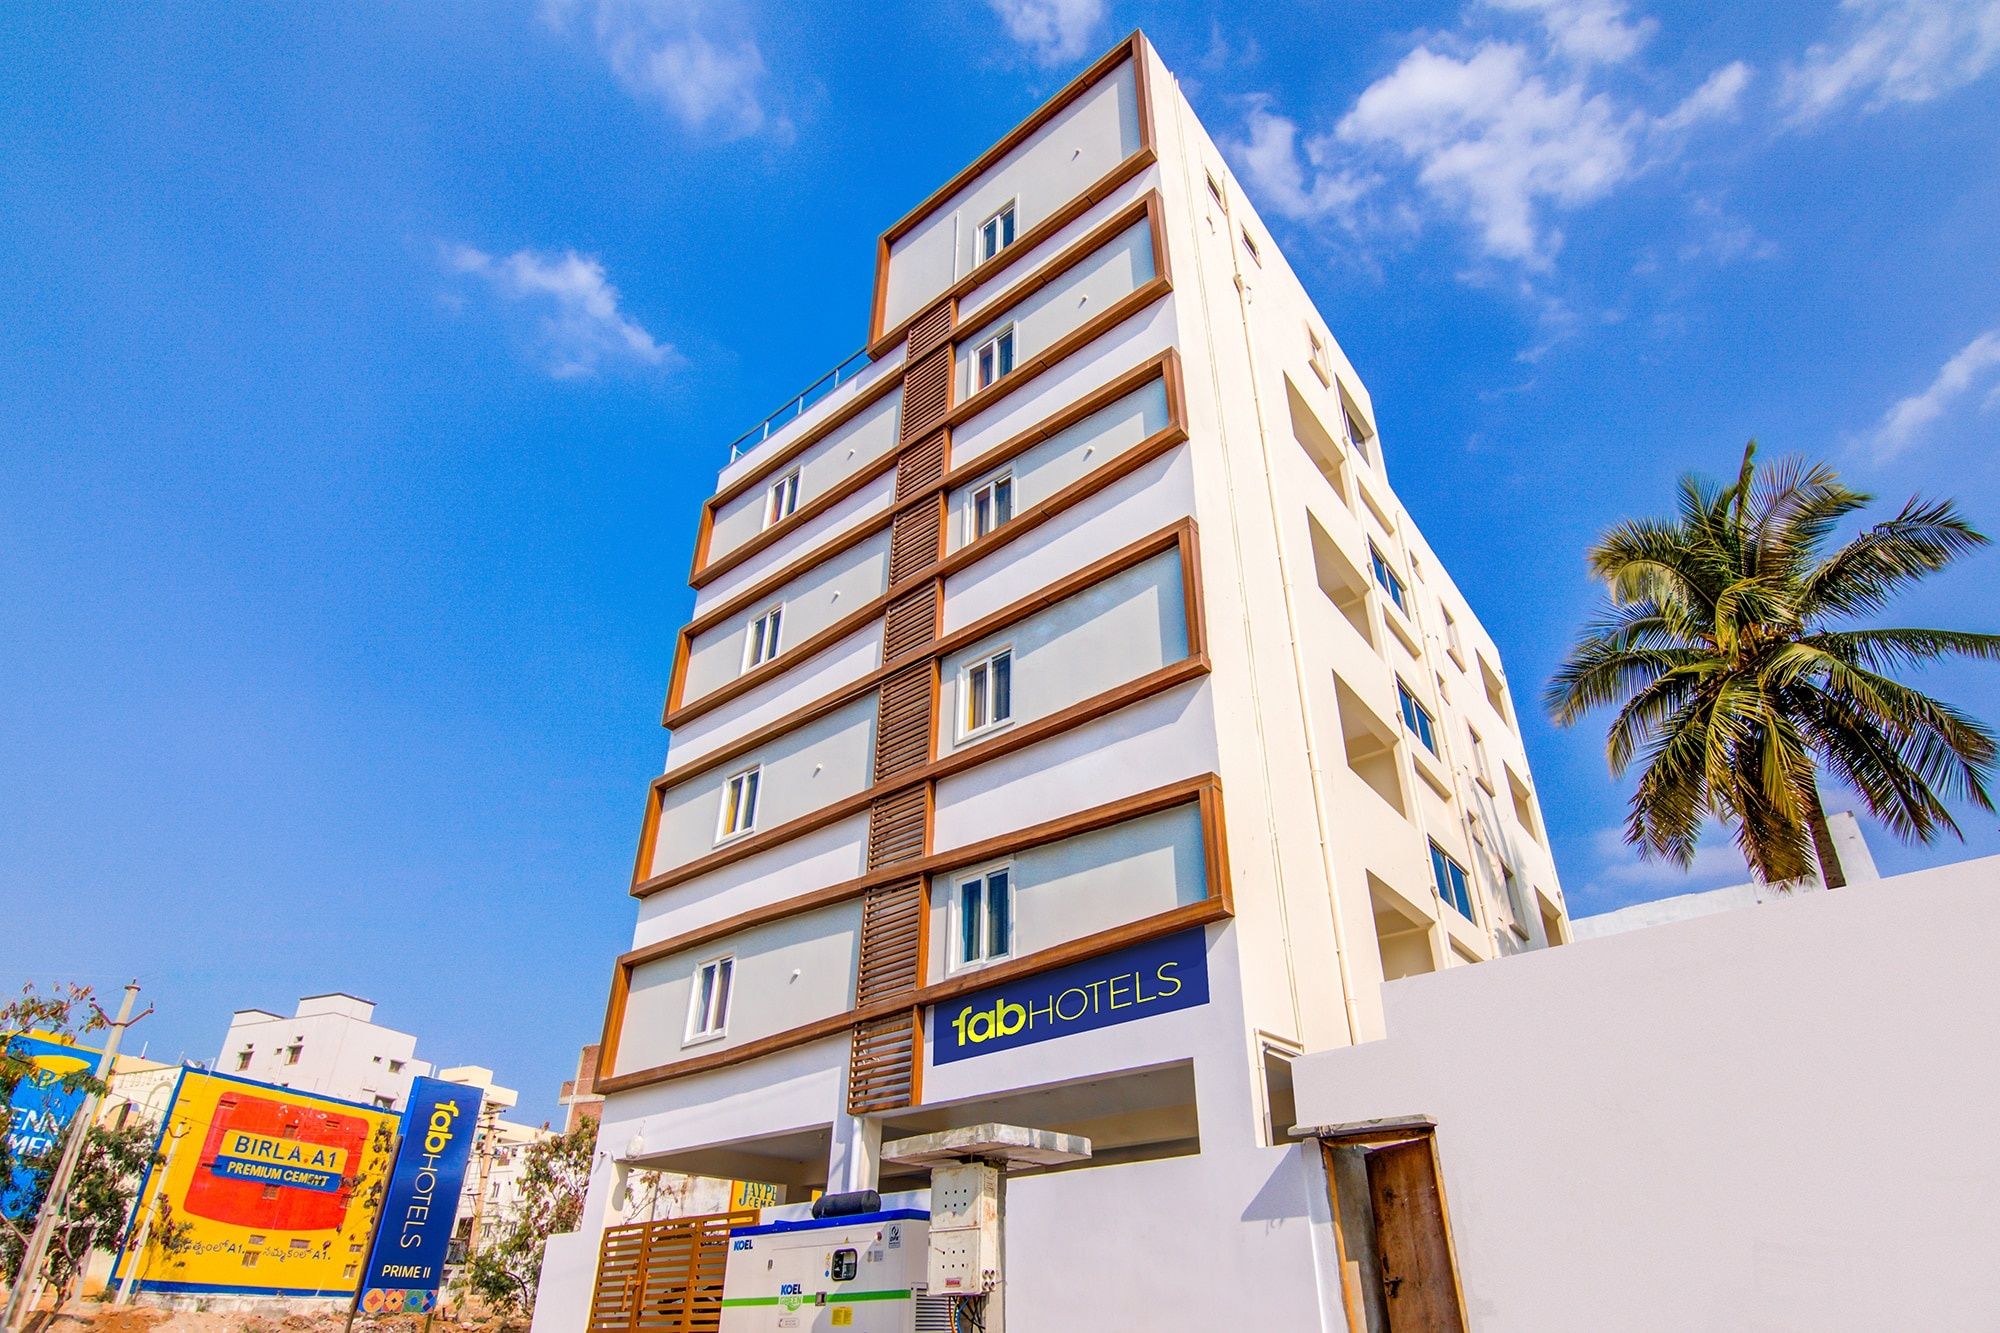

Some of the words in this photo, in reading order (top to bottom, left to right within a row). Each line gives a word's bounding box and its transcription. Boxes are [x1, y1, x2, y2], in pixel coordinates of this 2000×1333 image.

[952, 962, 1182, 1046] fabHOTELS
[226, 1161, 283, 1180] PREMIUM
[400, 1100, 460, 1248] fabHOTELS
[733, 1240, 753, 1251] KOEL
[382, 1264, 420, 1278] PRIME
[780, 1283, 802, 1295] KOEL
